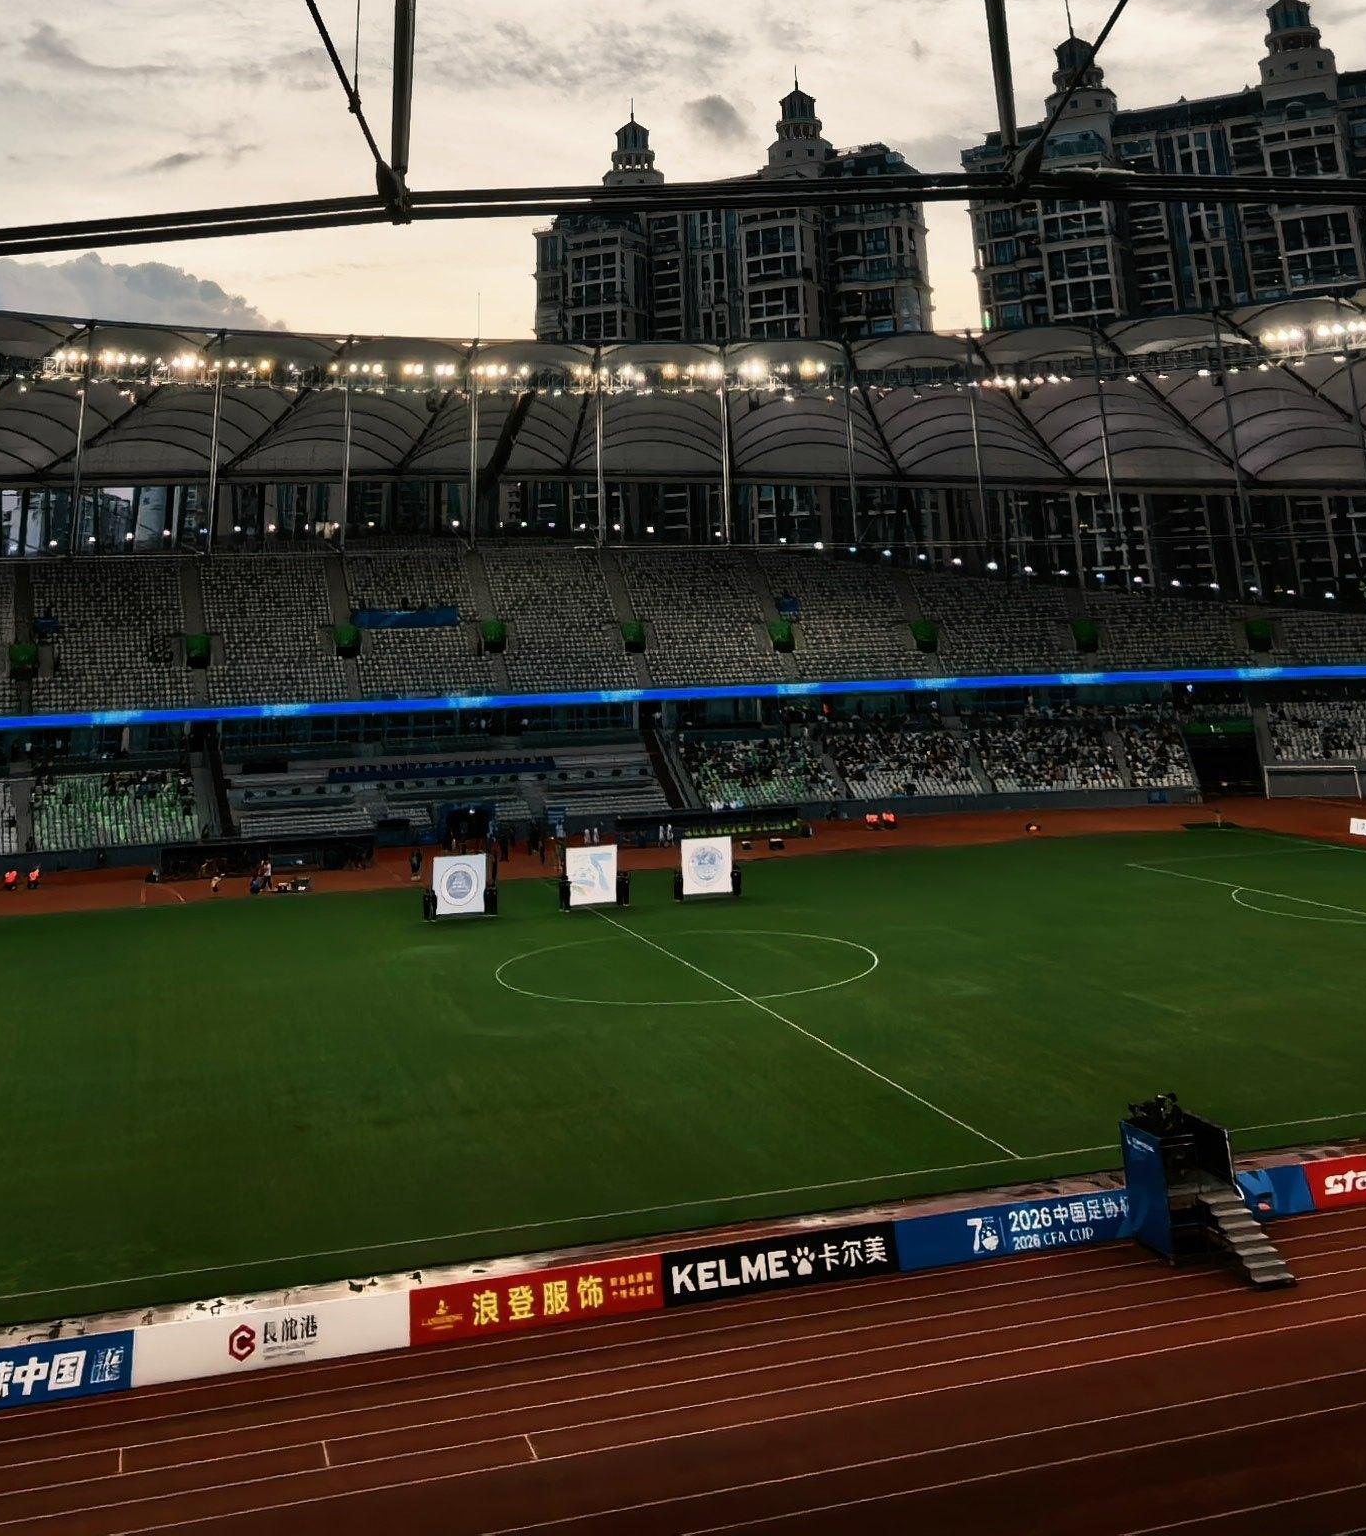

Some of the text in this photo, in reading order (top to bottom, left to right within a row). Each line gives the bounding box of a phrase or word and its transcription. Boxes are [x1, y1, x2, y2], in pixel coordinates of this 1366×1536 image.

[1012, 1226, 1094, 1251] 2026 CFA CUP
[671, 1250, 790, 1295] KELME
[818, 1235, 889, 1272] 卡尔美
[472, 1275, 605, 1326] 浪登服饰
